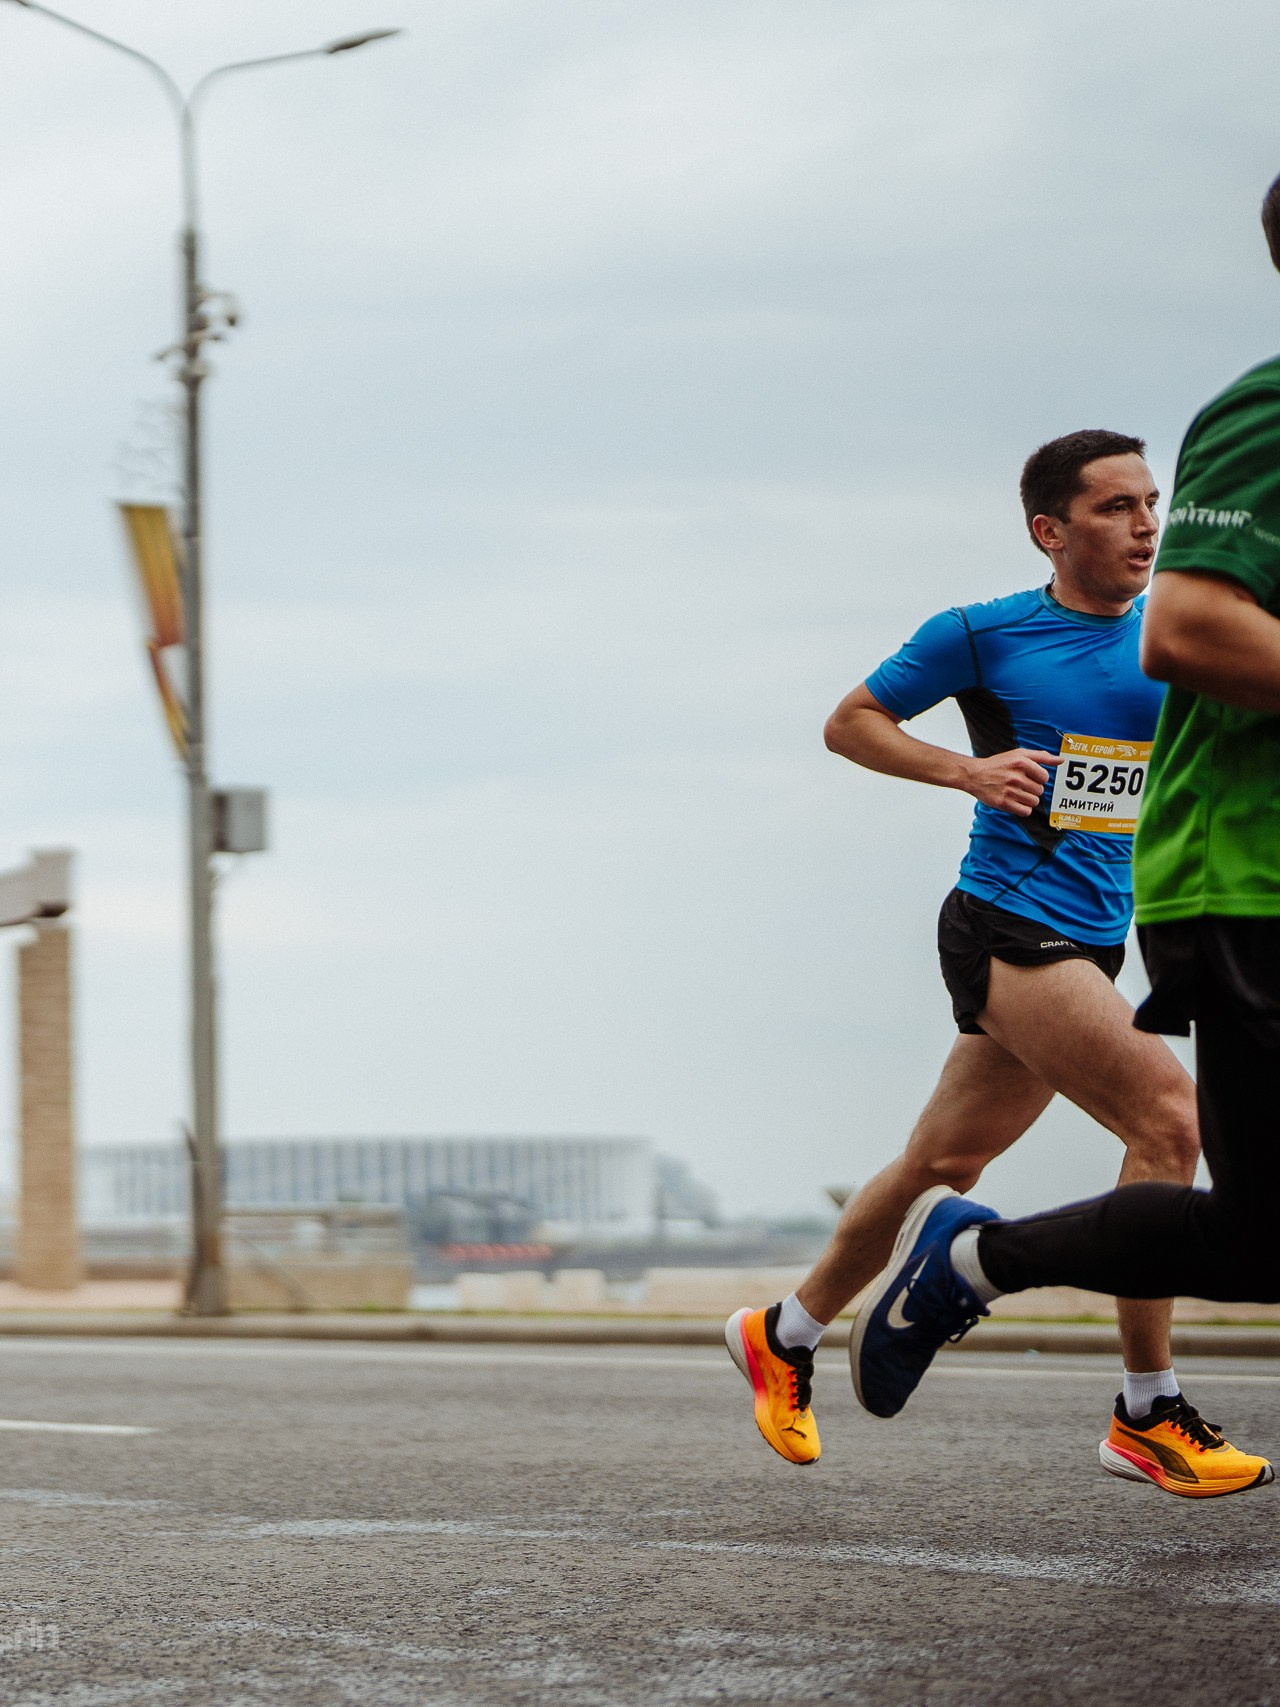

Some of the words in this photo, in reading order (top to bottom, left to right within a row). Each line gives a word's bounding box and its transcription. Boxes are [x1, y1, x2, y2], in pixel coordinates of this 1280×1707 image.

[1090, 744, 1116, 755] ГЕРОЙ!
[1065, 760, 1144, 795] 5250
[1059, 798, 1114, 813] ДМИТРИЙ
